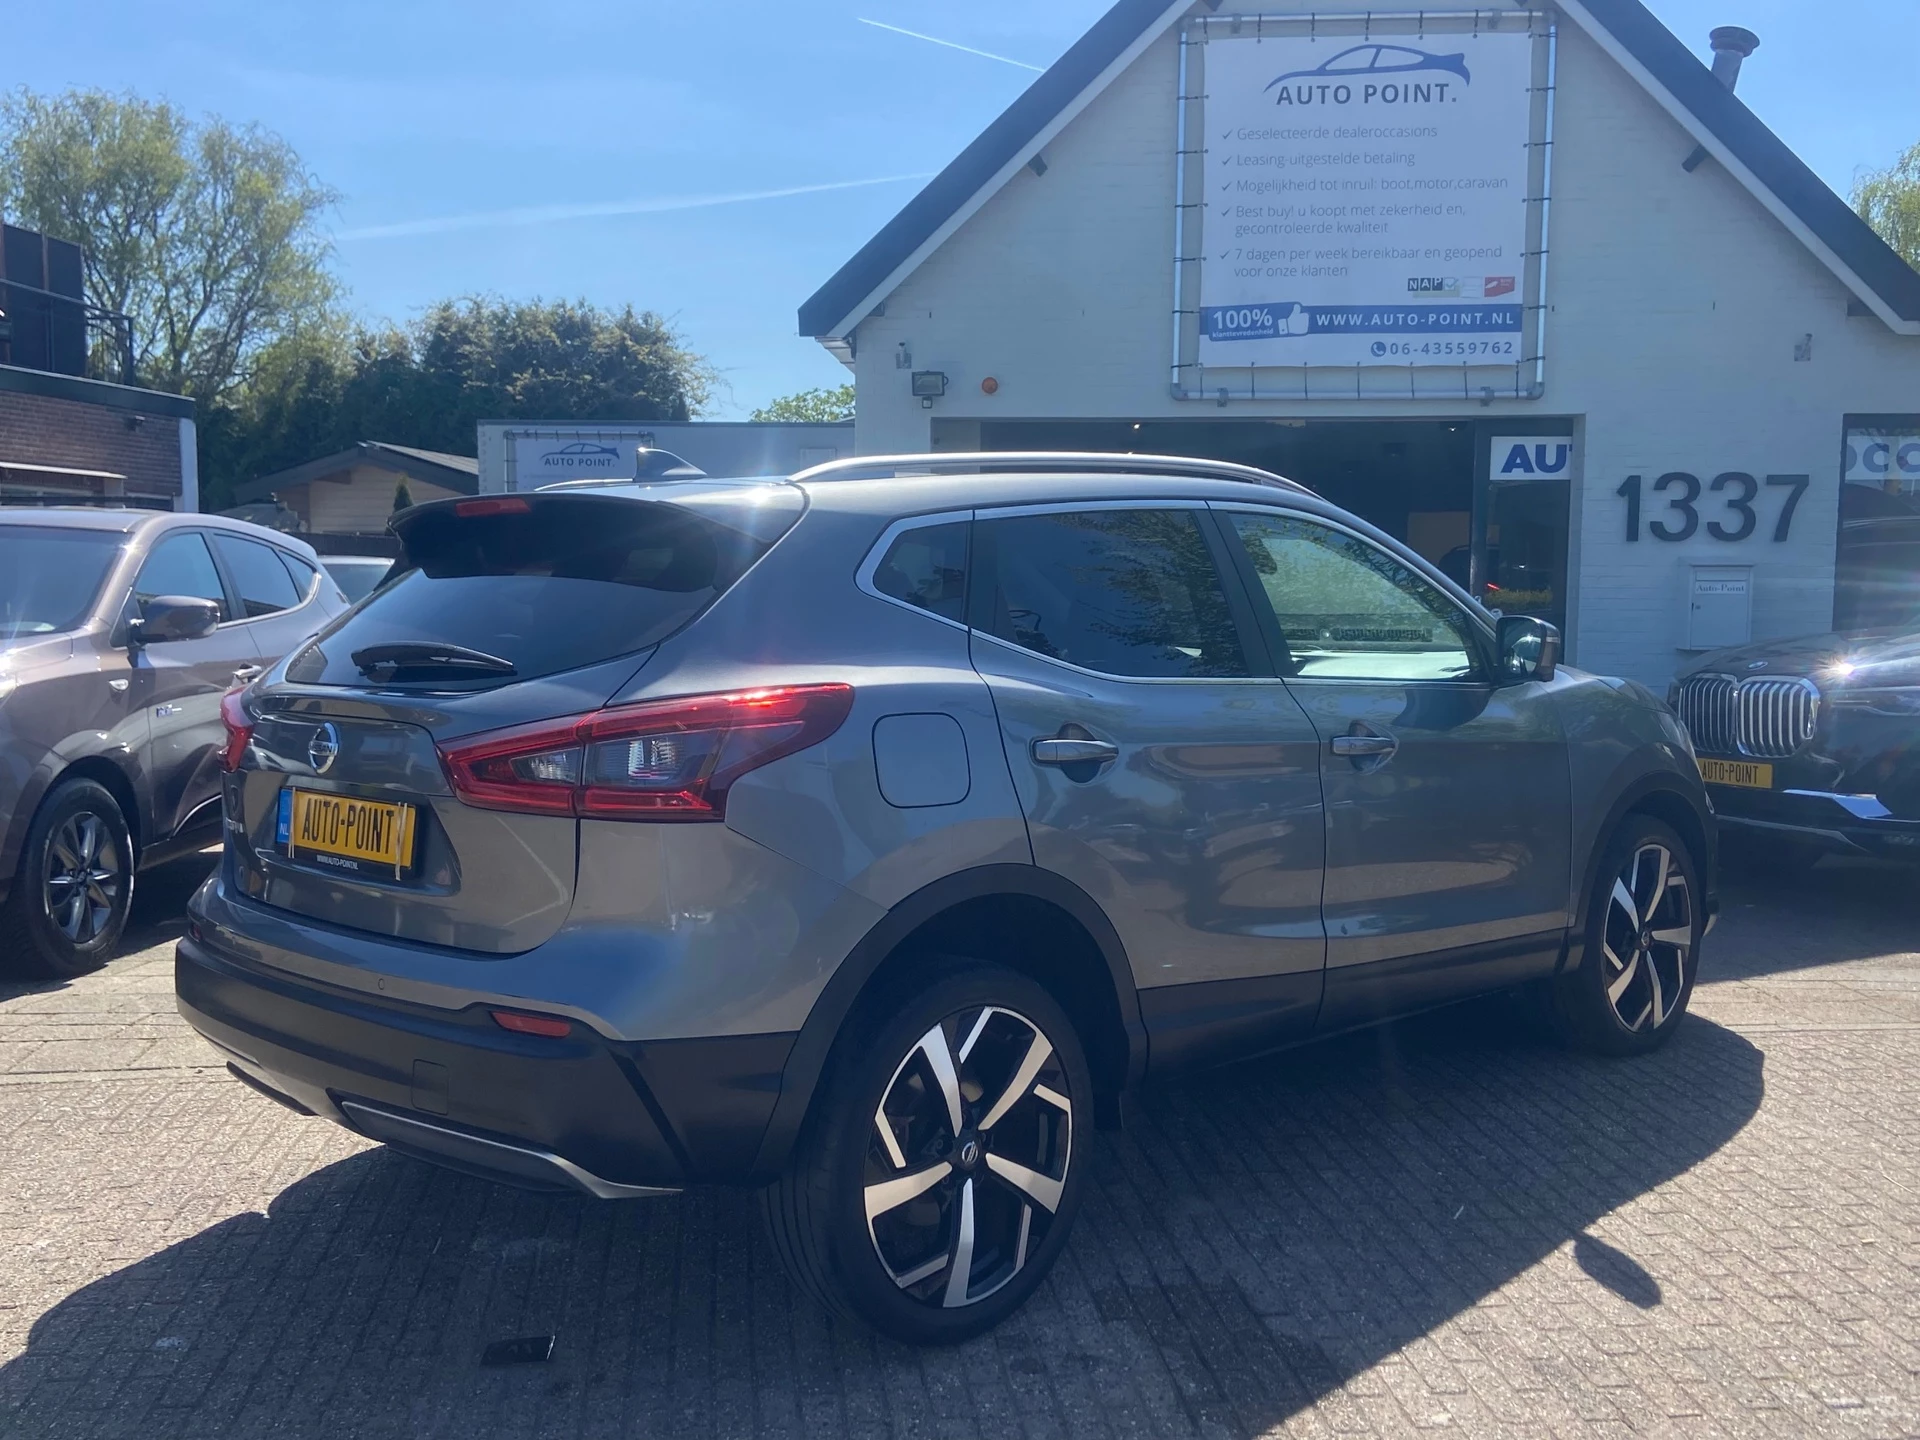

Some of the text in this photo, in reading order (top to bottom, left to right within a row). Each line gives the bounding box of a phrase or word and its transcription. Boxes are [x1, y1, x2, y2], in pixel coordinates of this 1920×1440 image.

[1275, 83, 1457, 105] AUTO POINT.
[1237, 125, 1438, 140] Geselecteerde dealeroccasions
[1364, 152, 1416, 167] betaling
[1236, 179, 1316, 195] Mogelijkheid
[1320, 180, 1338, 191] tot
[1342, 178, 1377, 190] inruil:
[1236, 203, 1466, 220] Best buy! u koopt met zekerheid en,
[1235, 221, 1389, 238] gecontroleerde kwaliteit
[1235, 246, 1502, 263] 7 dagen per week bereikbaar en geopend
[1234, 265, 1348, 277] voor onze klanten
[1408, 278, 1443, 291] NAP
[1213, 308, 1273, 329] 100%
[1316, 311, 1515, 327] WWW.AUTO-POINT.NL
[1390, 342, 1513, 356] 06-43559762
[545, 457, 574, 468] AUTO
[1500, 443, 1572, 474] AU
[1615, 472, 1810, 542] 1337
[1696, 583, 1745, 592] Auto-Point
[1702, 760, 1759, 784] AUTO-POINT
[280, 822, 289, 836] NL
[302, 797, 395, 854] AUTO-POINT
